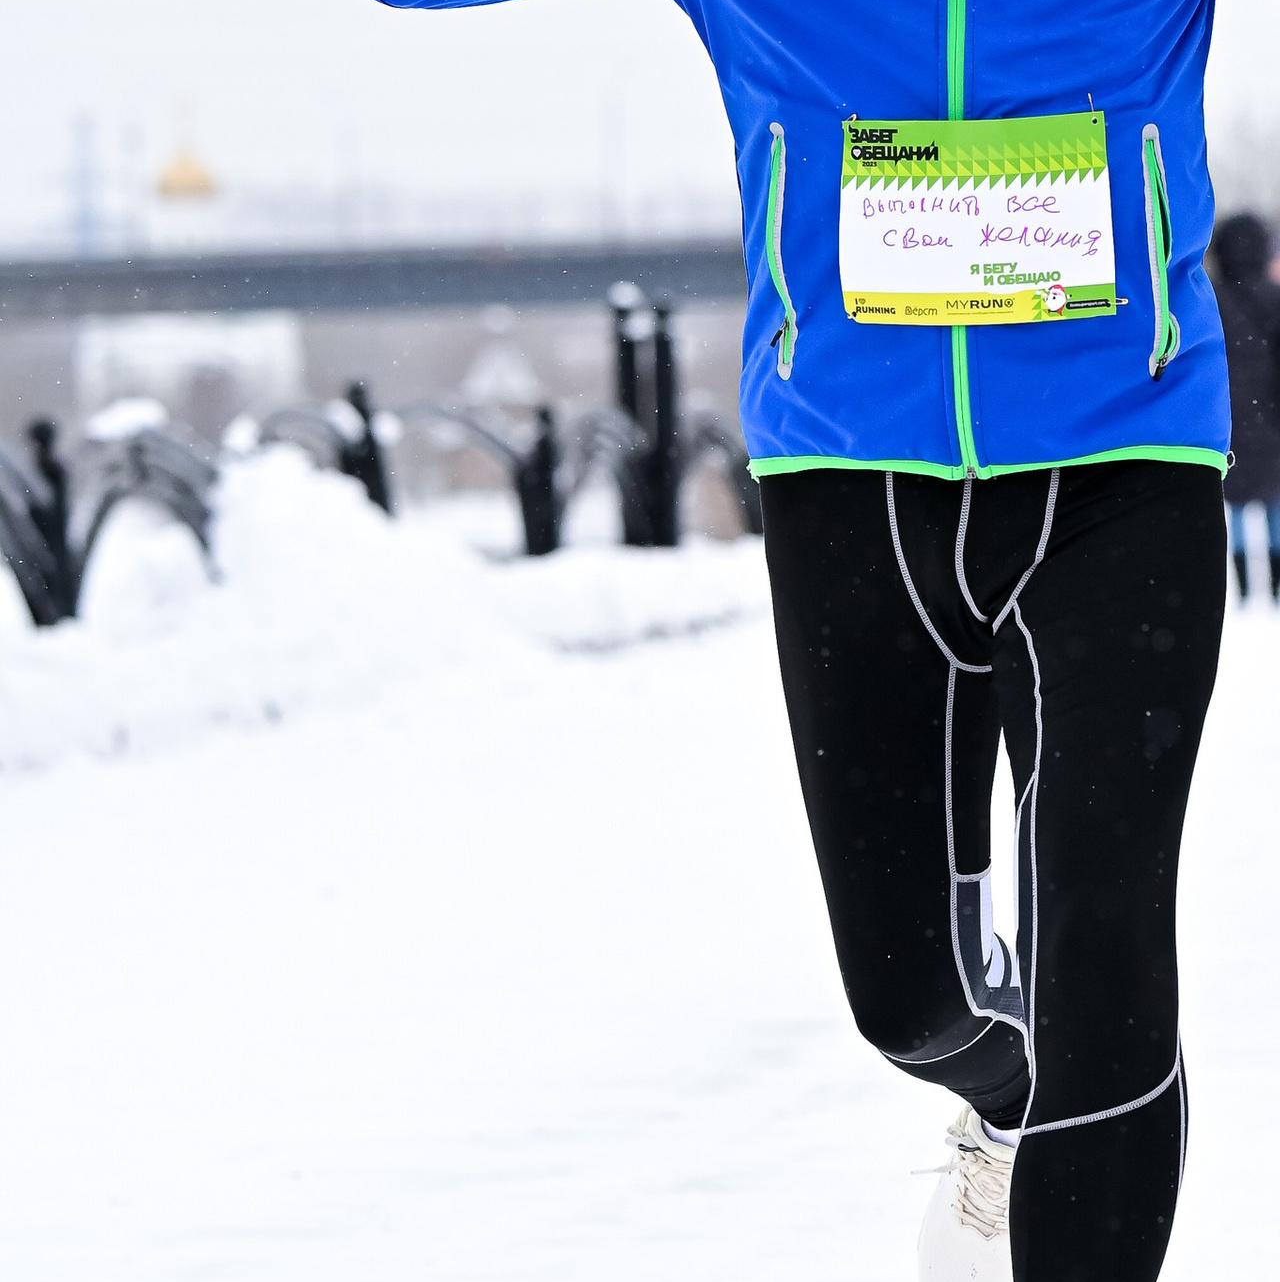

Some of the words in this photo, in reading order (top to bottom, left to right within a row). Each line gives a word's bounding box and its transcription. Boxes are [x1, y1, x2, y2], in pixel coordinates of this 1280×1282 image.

[851, 128, 898, 144] ЗАБЕГ
[851, 141, 939, 166] ОБЕЩАНИЙ
[970, 264, 979, 275] Я
[983, 262, 1018, 274] БЕГУ
[983, 275, 994, 286] И
[997, 270, 1061, 285] ОБЕЩАЮ
[855, 306, 896, 314] RUNNING
